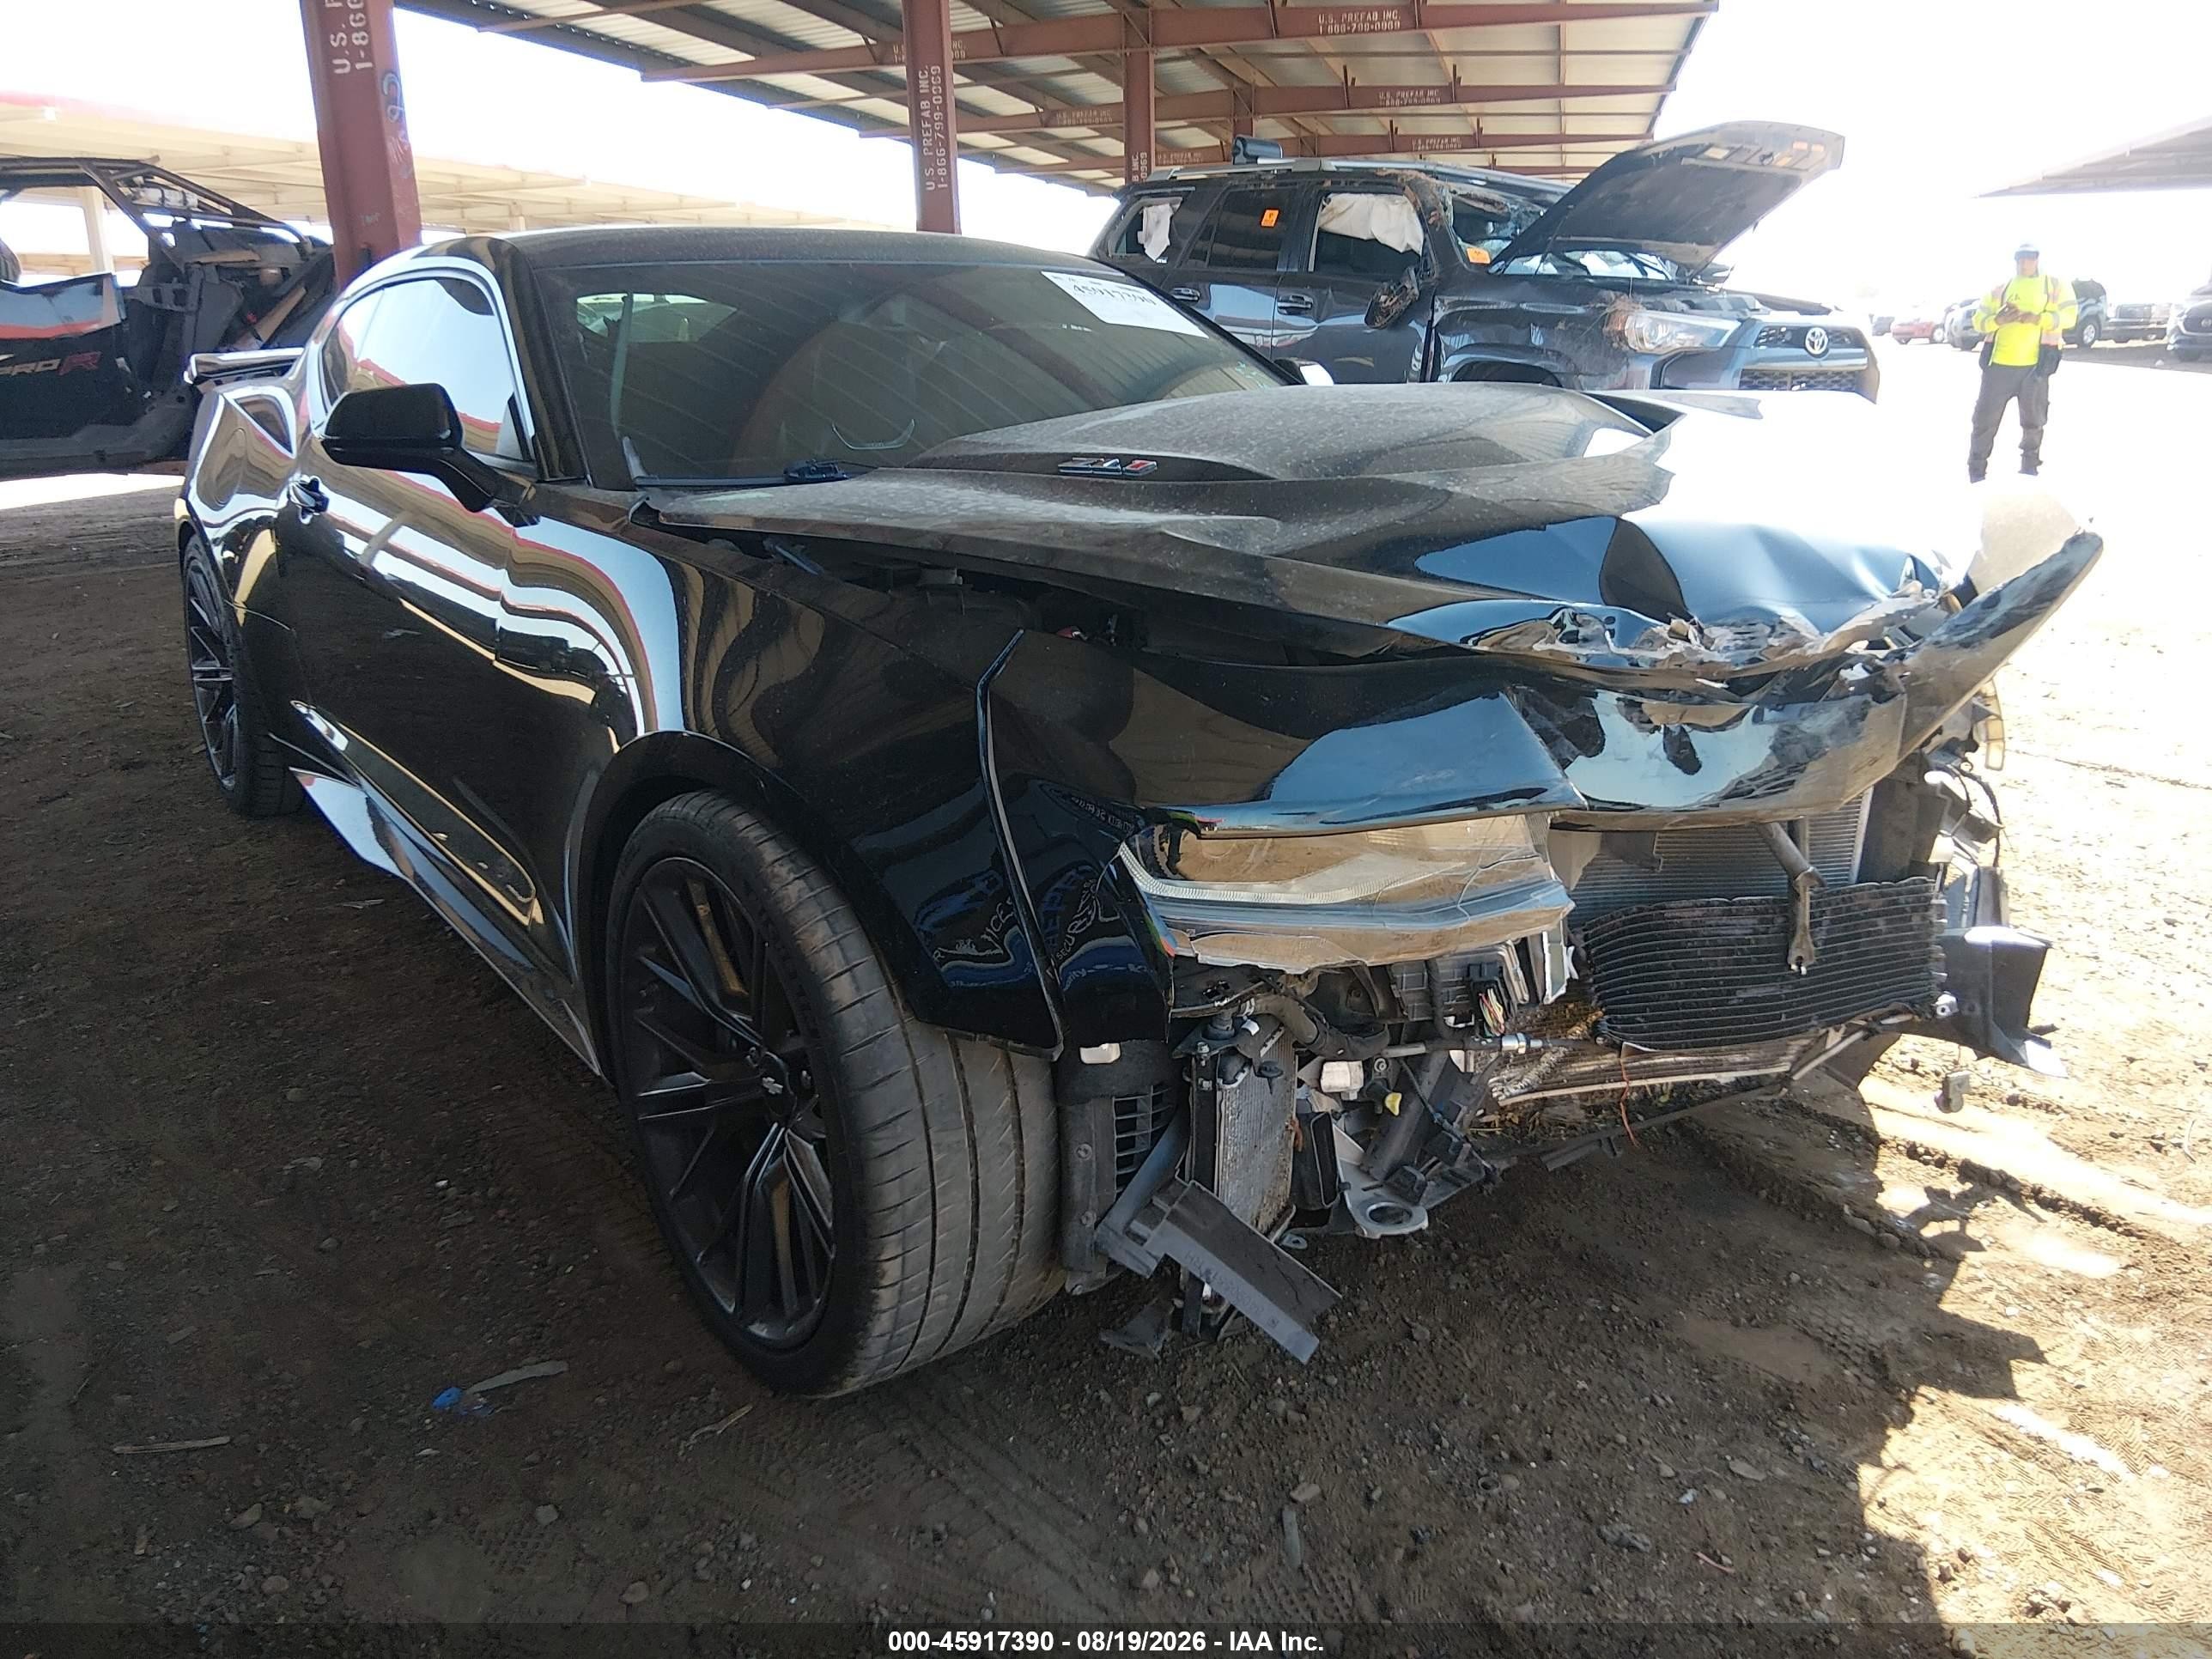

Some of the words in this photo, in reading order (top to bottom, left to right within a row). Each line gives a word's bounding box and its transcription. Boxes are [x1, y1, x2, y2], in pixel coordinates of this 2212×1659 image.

[330, 23, 351, 74] U.S.
[918, 65, 930, 94] INC.
[920, 100, 933, 155] PREFAB
[1057, 457, 1158, 477] ZL1
